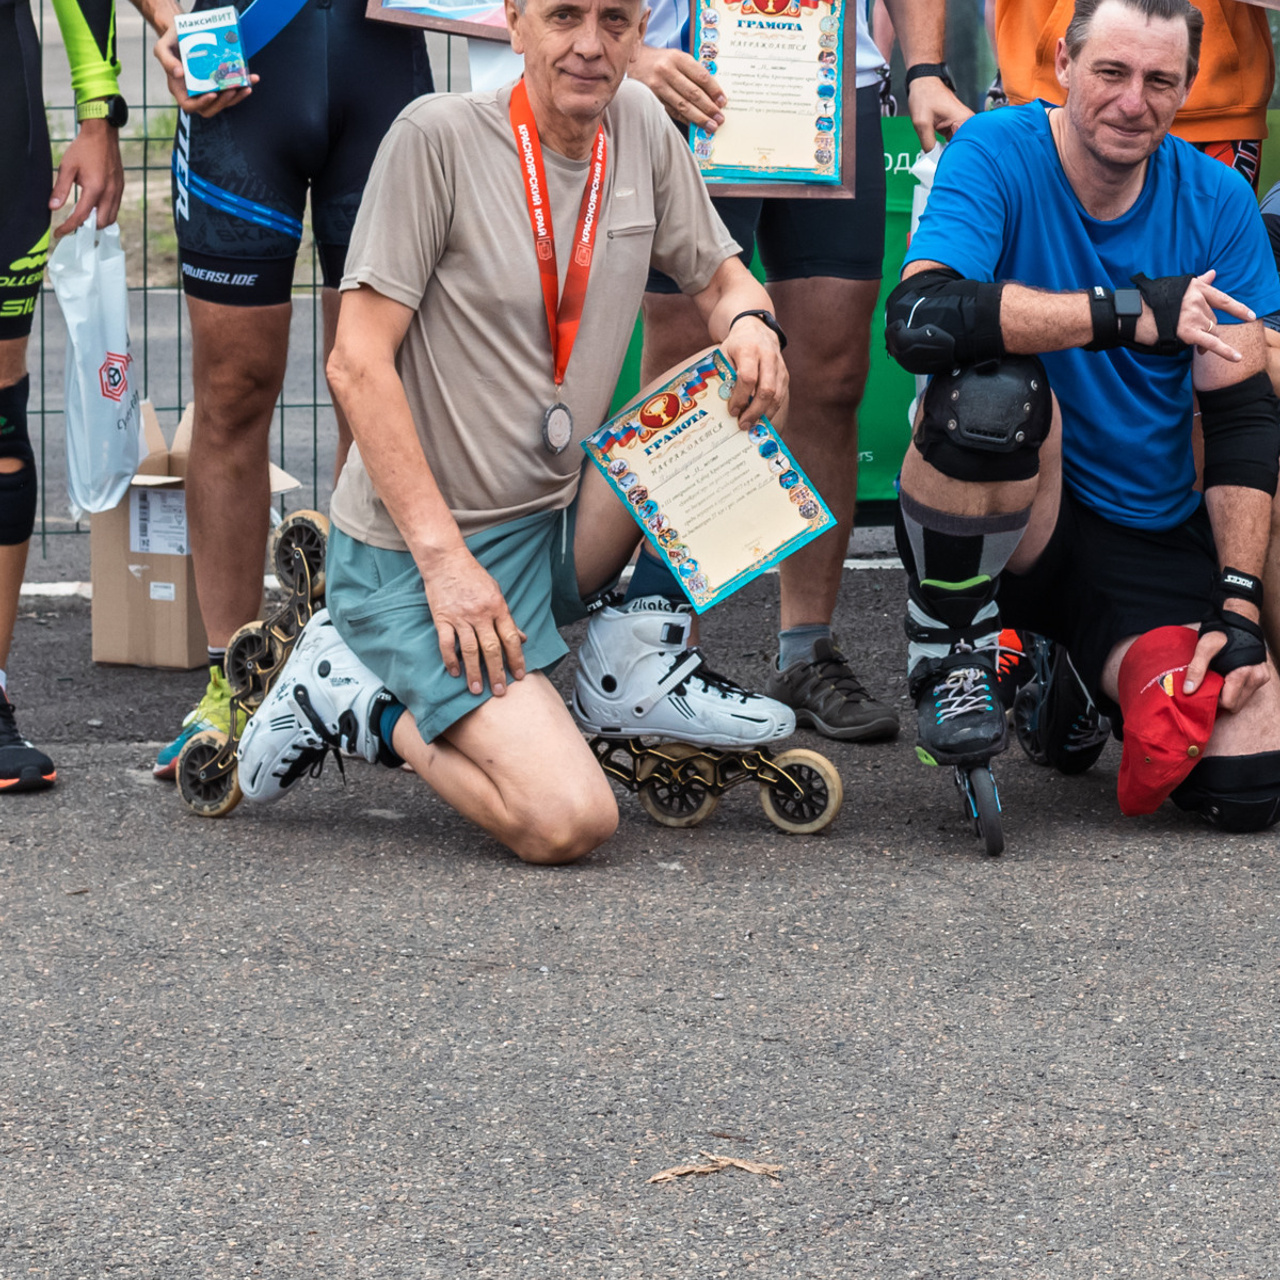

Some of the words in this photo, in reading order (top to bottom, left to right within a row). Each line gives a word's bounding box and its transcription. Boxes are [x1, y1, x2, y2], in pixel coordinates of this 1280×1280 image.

[178, 12, 232, 29] МаксиВИТ
[737, 19, 804, 32] ГРАМОТА
[518, 124, 542, 206] КРАСНОЯРСКИЙ
[534, 208, 548, 237] КРАЙ
[582, 162, 602, 243] КРАСНОЯРСКИЙ
[596, 133, 604, 160] КРАЙ
[181, 262, 259, 287] POWERSLIDE
[644, 409, 709, 456] ГРАМОТА
